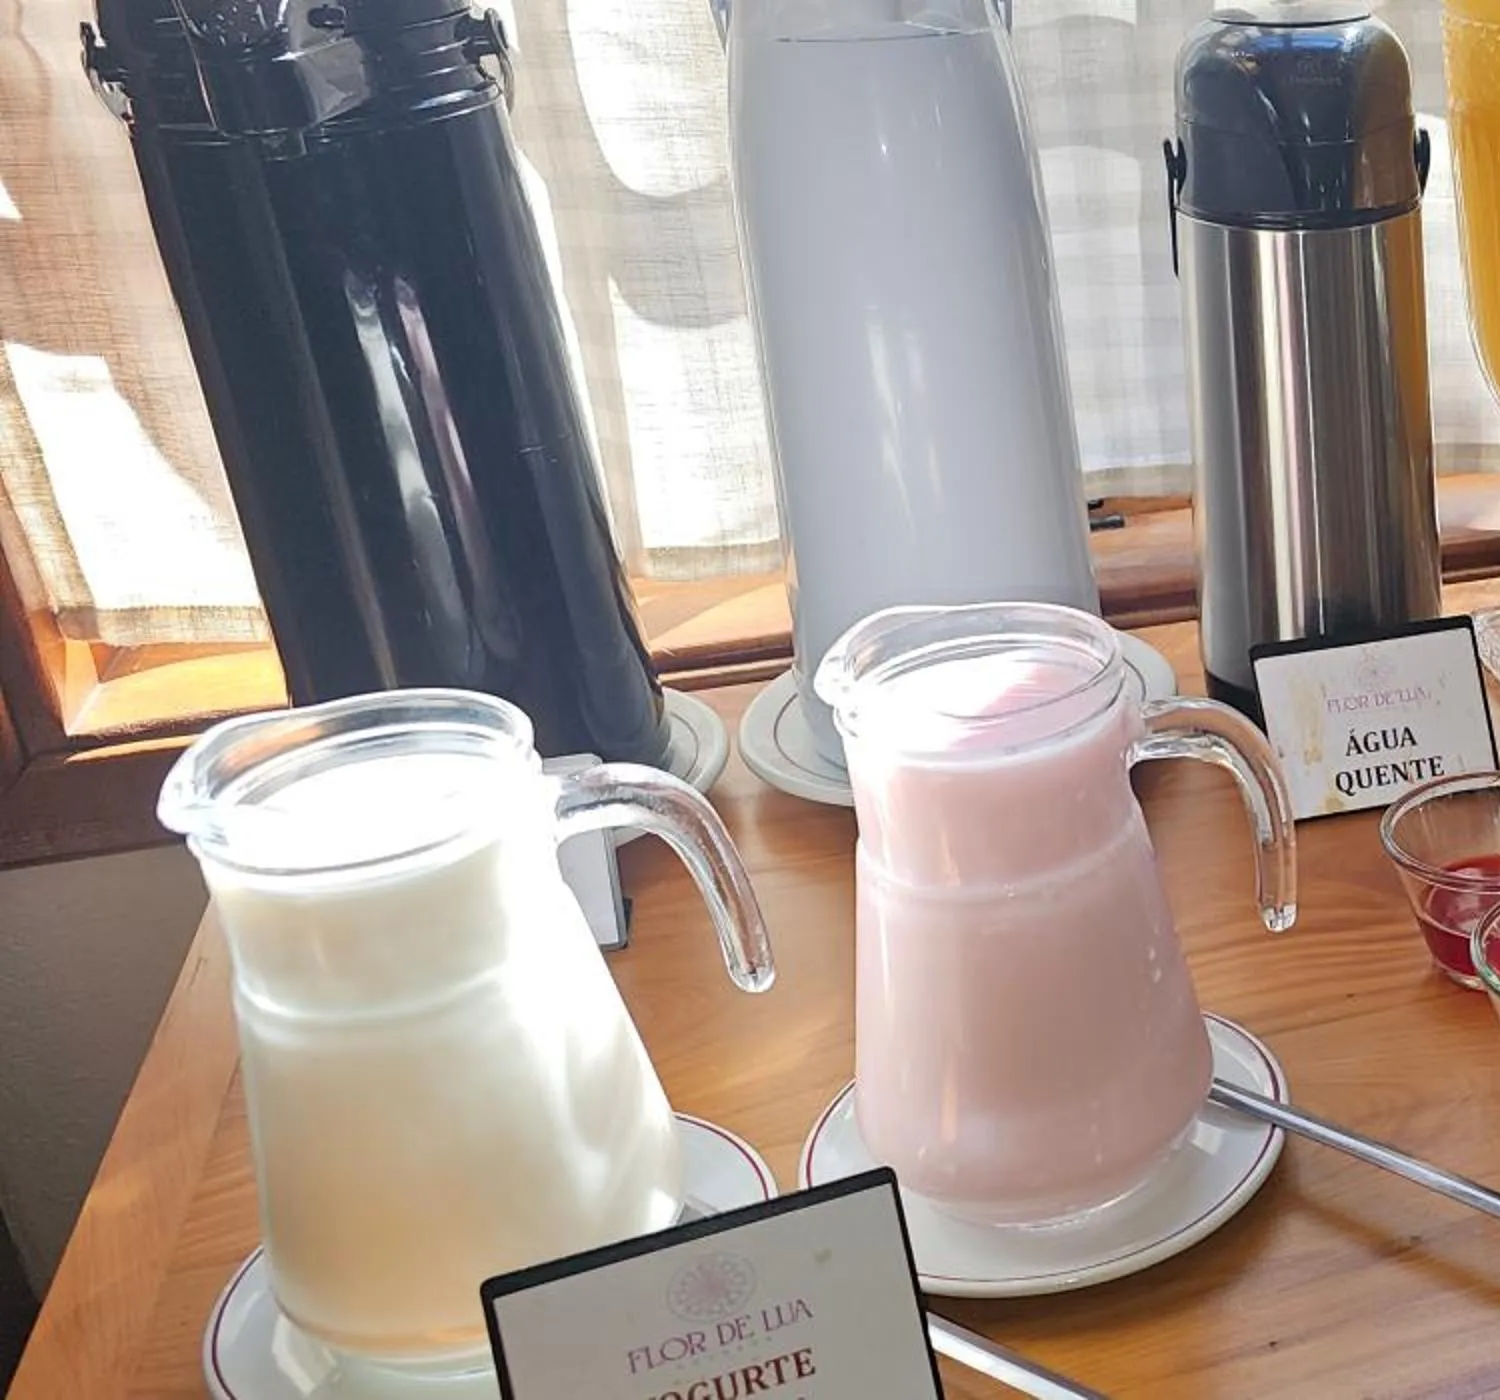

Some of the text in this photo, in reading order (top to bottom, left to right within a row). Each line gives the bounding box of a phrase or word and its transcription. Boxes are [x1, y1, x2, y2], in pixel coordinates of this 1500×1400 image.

[1374, 689, 1395, 706] DE
[1345, 725, 1418, 757] ÁGUA
[1335, 755, 1445, 797] QUENTE
[627, 1331, 706, 1374] FLOR
[716, 1314, 755, 1346] DE
[761, 1298, 813, 1332] LUA
[647, 1348, 816, 1400] GURTE
